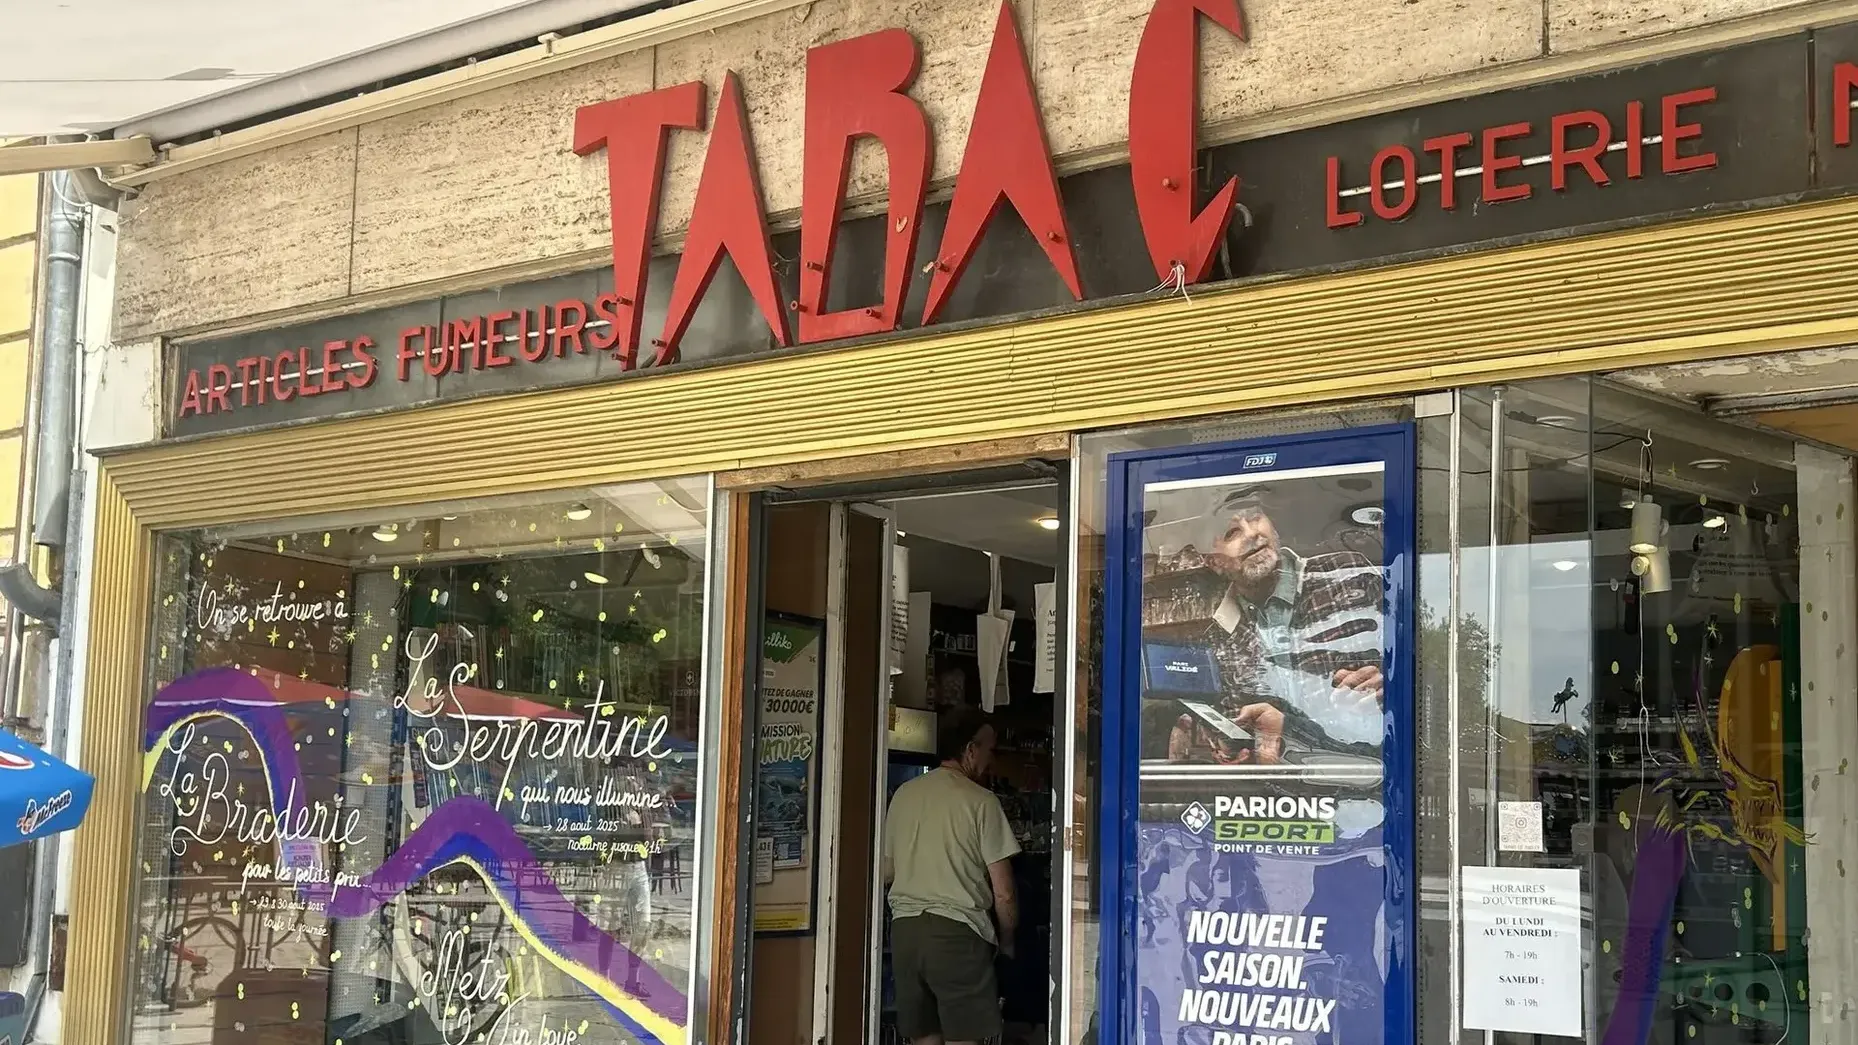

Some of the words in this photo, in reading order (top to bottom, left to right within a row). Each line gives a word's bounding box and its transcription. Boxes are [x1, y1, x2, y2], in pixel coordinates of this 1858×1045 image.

[1326, 86, 1719, 230] LOTERIE
[573, 0, 1247, 371] TABAC
[179, 335, 378, 417] ARTICLES
[396, 293, 620, 382] FUMEURS
[1246, 456, 1264, 466] FDJ
[198, 581, 226, 629] On
[231, 604, 248, 623] se
[255, 580, 325, 623] retrouve
[393, 630, 445, 717] La
[776, 688, 785, 697] DE
[785, 689, 814, 698] GAGNER
[420, 662, 672, 811] Serpentine
[761, 723, 800, 738] MISSION
[160, 723, 199, 817] La
[171, 752, 368, 856] Braderie
[521, 780, 550, 820] qui
[555, 786, 592, 806] nous
[1215, 796, 1336, 820] PARIONS
[556, 818, 568, 832] 28
[596, 820, 619, 832] 2025
[1218, 823, 1331, 840] SPORT
[1214, 843, 1252, 853] POINT
[1256, 845, 1272, 853] DE
[1277, 846, 1320, 855] VENTE
[241, 862, 272, 895] pour
[275, 856, 292, 880] les
[293, 859, 330, 891] petits
[1482, 896, 1557, 906] D'OUVERTURE
[1492, 884, 1546, 894] HORAIRES
[264, 916, 285, 932] toute
[288, 918, 296, 931] la
[1187, 910, 1328, 950] NOUVELLE
[1483, 928, 1497, 936] AU
[1500, 928, 1552, 937] VENDREDI
[1495, 917, 1510, 925] DU
[1513, 917, 1544, 926] LUNDI
[1504, 951, 1515, 959] 7h
[1523, 951, 1538, 959] 19h
[1199, 950, 1308, 990] SAISON.
[1499, 975, 1539, 984] SAMEDI
[420, 930, 531, 1045] Metz
[1178, 988, 1337, 1033] NOUVEAUX
[1505, 998, 1515, 1006] 8h
[1523, 999, 1538, 1007] 19h
